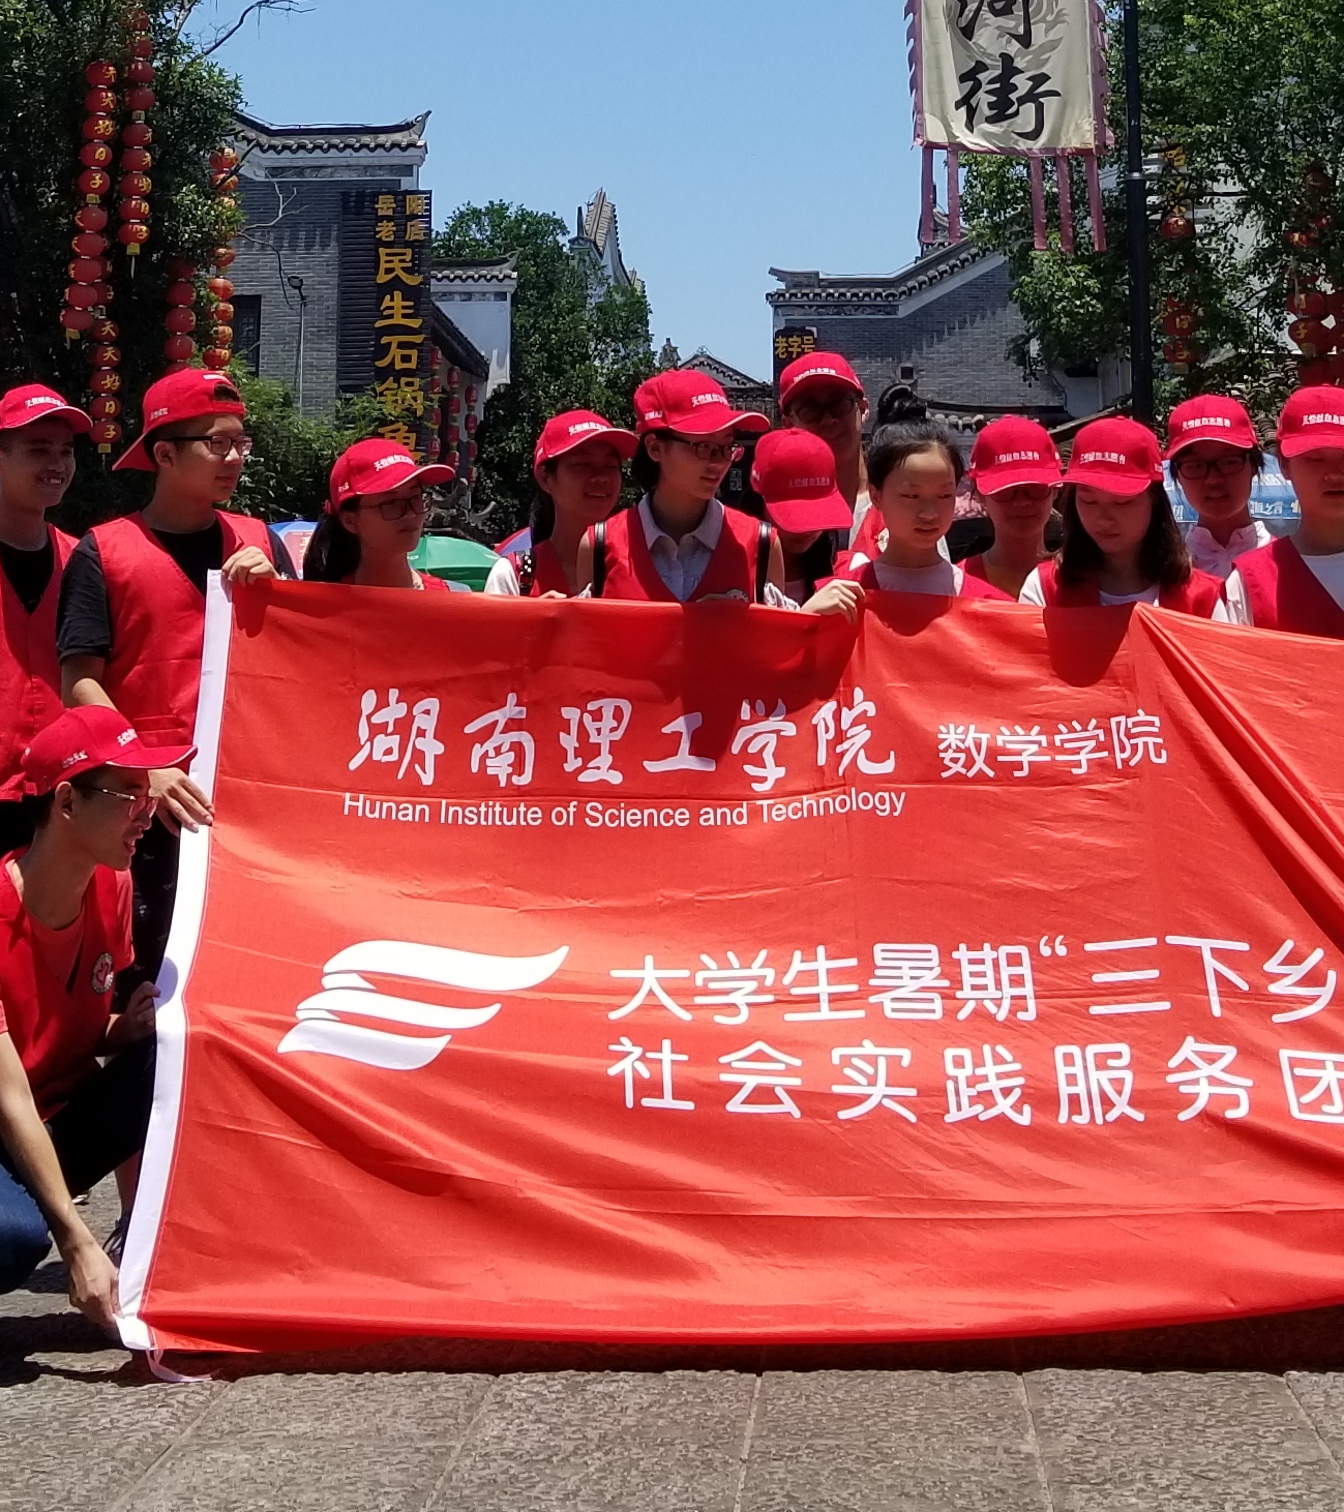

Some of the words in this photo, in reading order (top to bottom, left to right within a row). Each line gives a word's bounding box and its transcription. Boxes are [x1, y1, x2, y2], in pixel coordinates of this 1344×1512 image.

[100, 318, 121, 440] 天天好日子
[775, 335, 816, 359] 老字号
[348, 686, 895, 792] 湖南理工学院
[937, 708, 1168, 780] 数学学院
[343, 792, 430, 823] Hunan
[440, 799, 543, 827] Institute
[551, 801, 578, 827] of
[584, 801, 690, 828] Science
[698, 801, 748, 826] and
[756, 787, 907, 824] Technology
